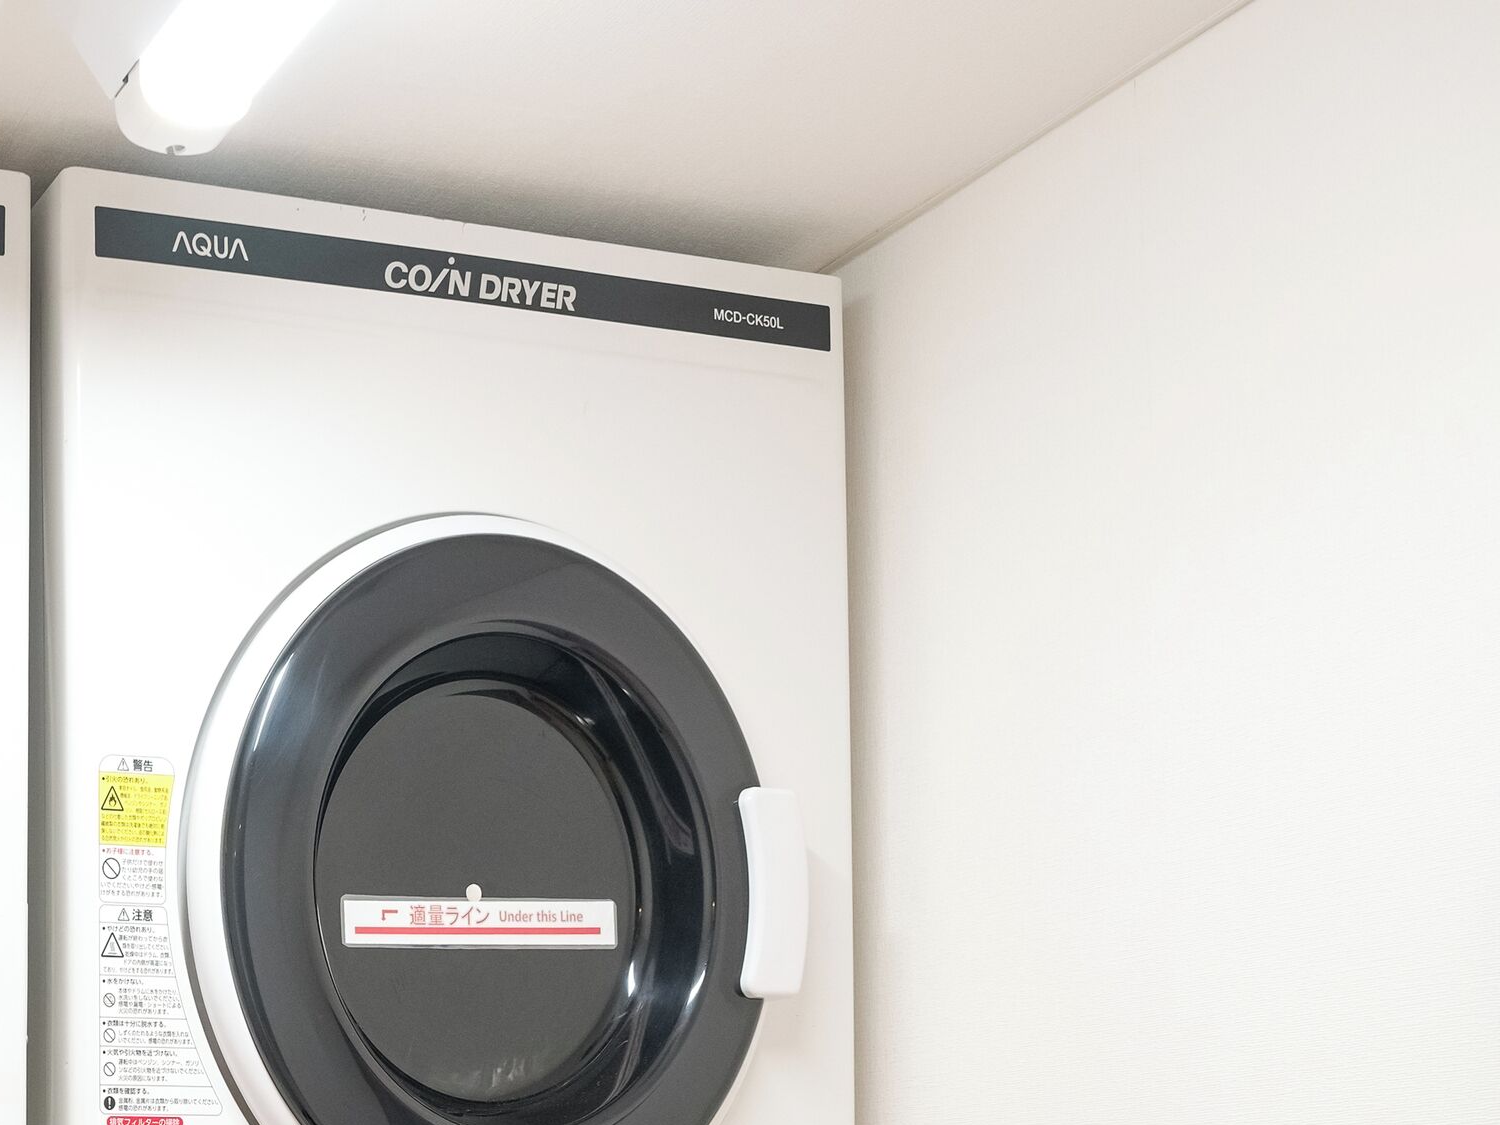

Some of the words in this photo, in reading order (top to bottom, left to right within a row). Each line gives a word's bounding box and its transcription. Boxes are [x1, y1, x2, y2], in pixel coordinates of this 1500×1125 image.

[172, 231, 248, 262] AQUA
[384, 257, 471, 297] COIN
[479, 272, 576, 312] DRYER
[713, 308, 784, 330] MCD-CK50L
[133, 759, 153, 772] 警告
[132, 909, 153, 922] 注意
[409, 904, 490, 926] 適量ライン
[499, 911, 532, 922] Under
[536, 910, 556, 922] this
[560, 910, 583, 922] Line
